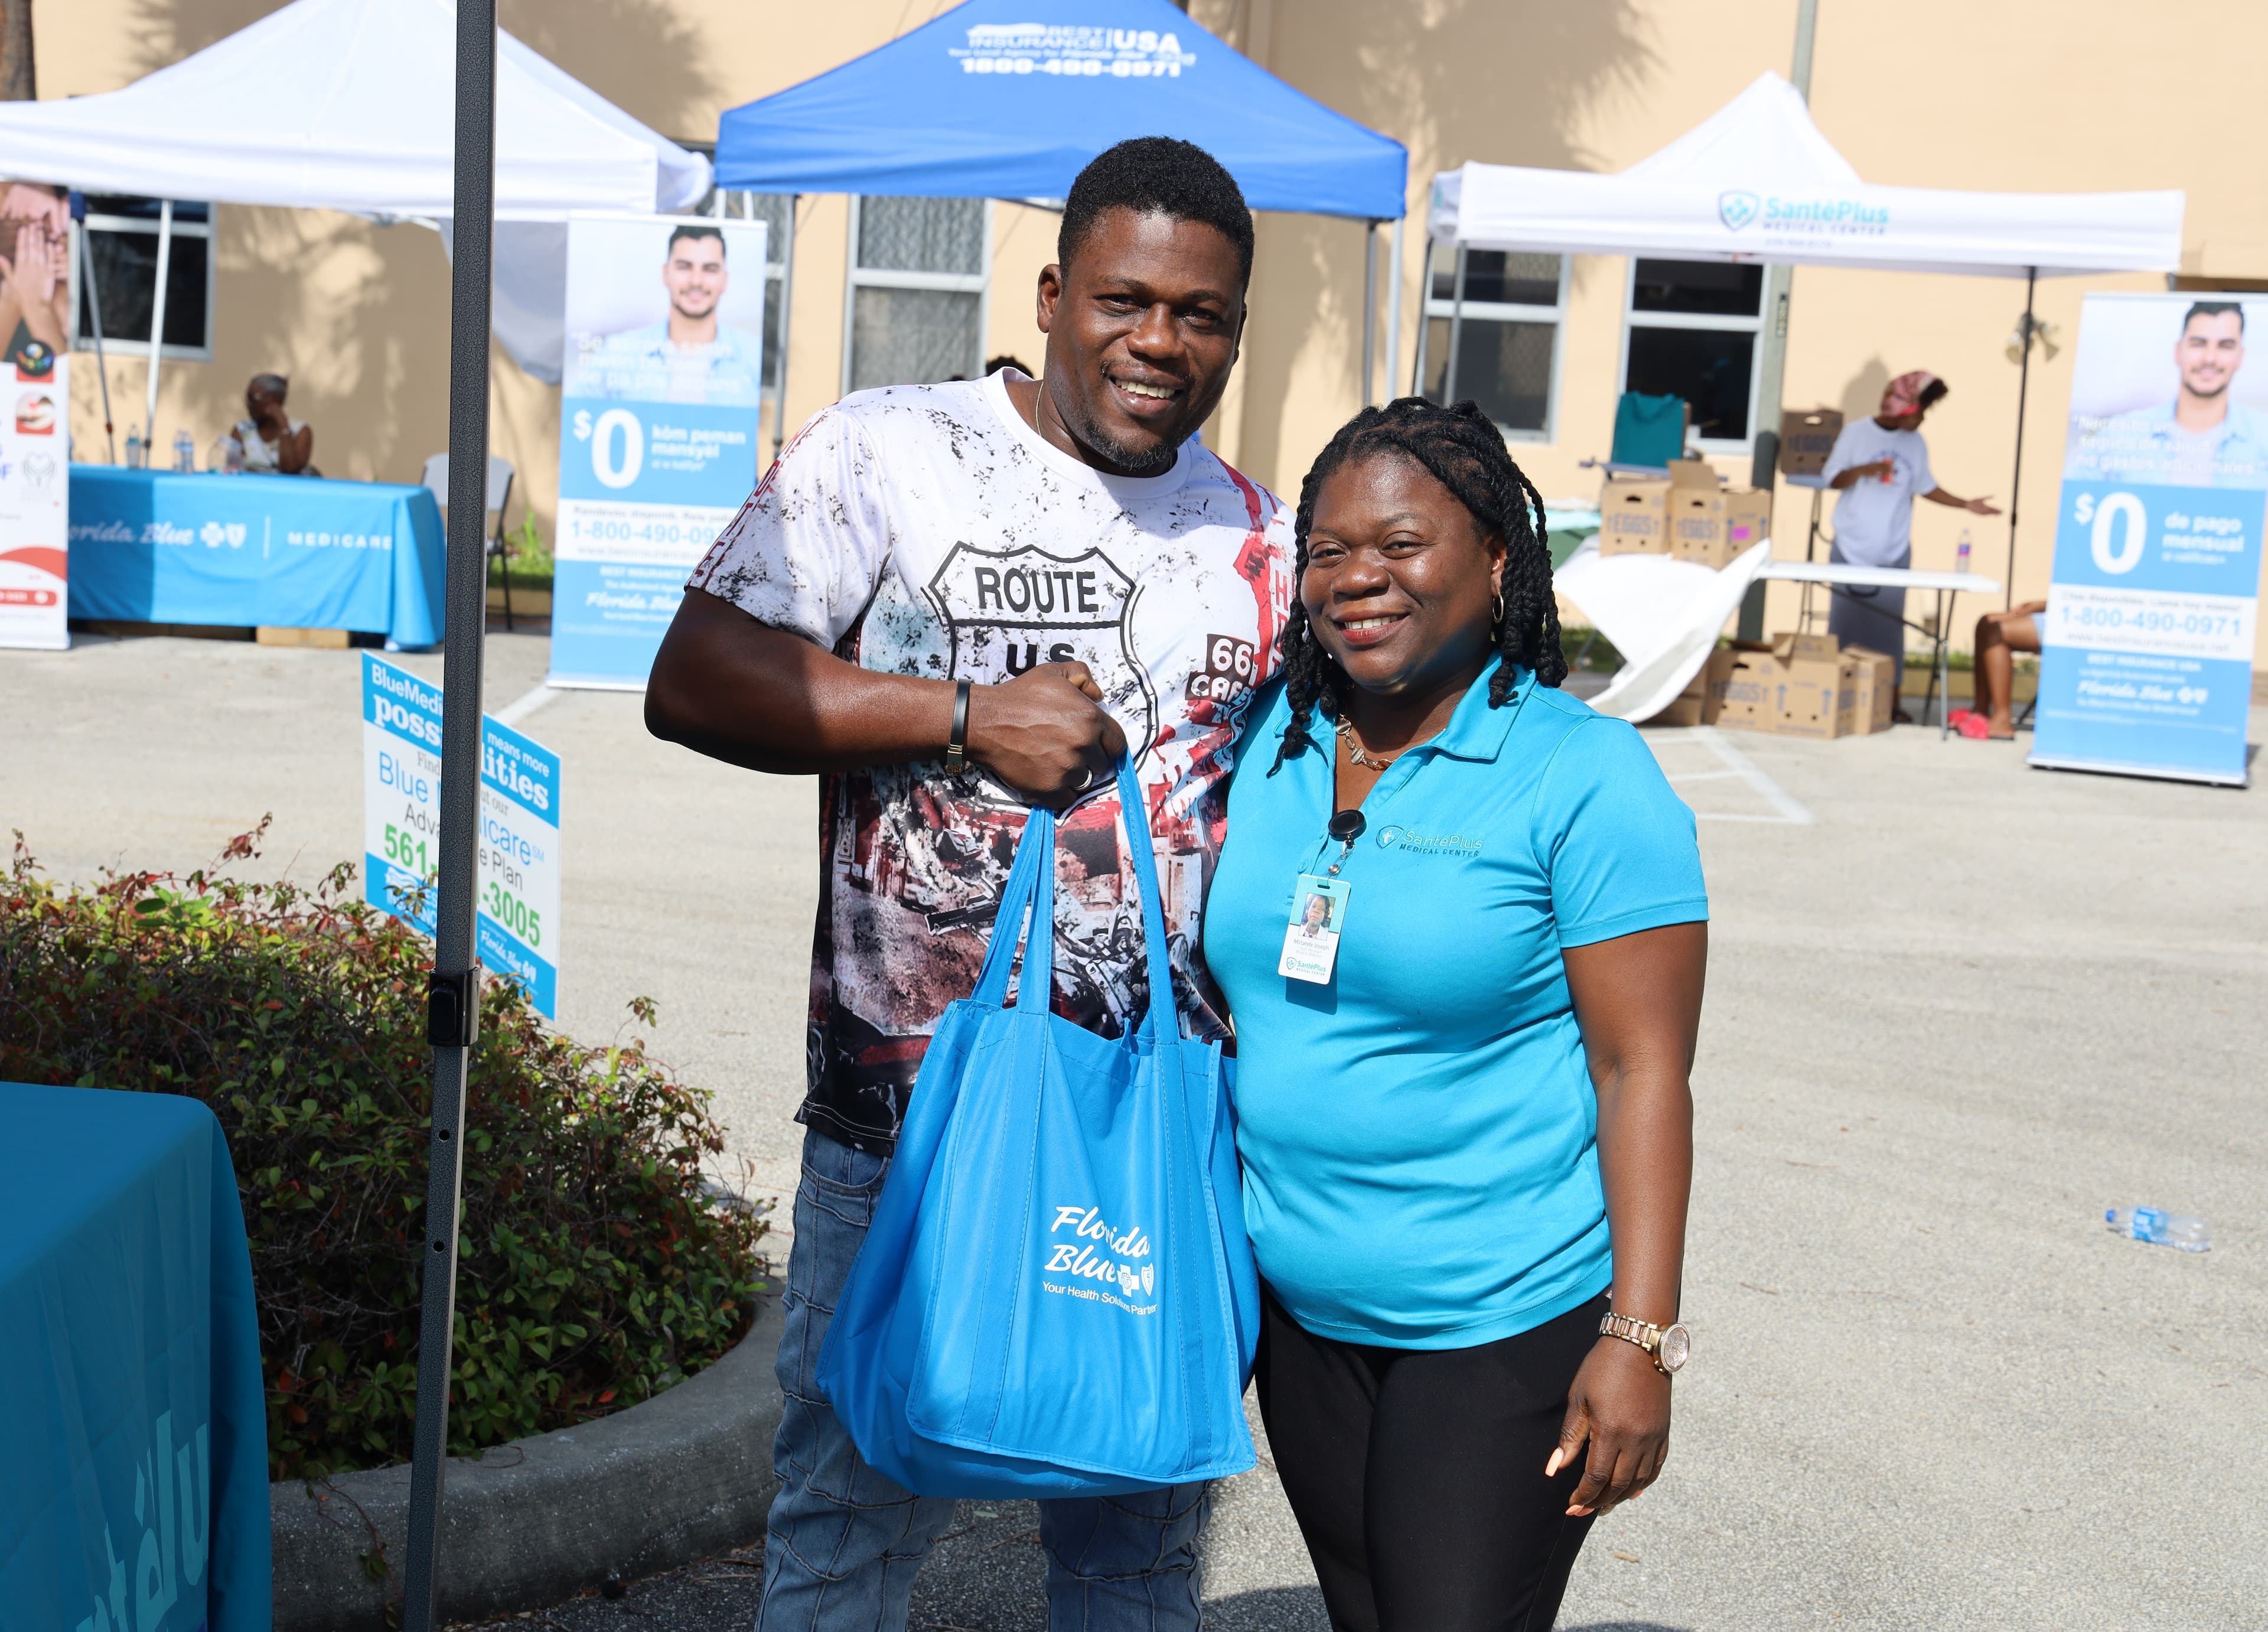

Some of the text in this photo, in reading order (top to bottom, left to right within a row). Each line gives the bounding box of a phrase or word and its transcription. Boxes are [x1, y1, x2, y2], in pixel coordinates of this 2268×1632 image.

[1113, 29, 1181, 54] USA
[69, 519, 392, 550] orida Blue MEDICARE
[572, 520, 716, 545] 1-800-490-09
[2192, 516, 2243, 536] pago
[975, 566, 1099, 614] ROUTE
[2062, 605, 2240, 637] 1-800-490-0971
[1212, 638, 1253, 676] 66
[372, 662, 549, 778] BlueMedi means more
[380, 751, 428, 803] Blue
[1399, 843, 1480, 857] MEDICAL CENTER
[1403, 830, 1482, 849] SantéPlus
[493, 851, 523, 891] Plan
[1314, 942, 1329, 950] Joseph
[1296, 960, 1327, 973] SantéPlus
[1050, 1206, 1151, 1258] Florida
[1044, 1244, 1116, 1283] Blue
[1042, 1281, 1066, 1294] Your
[1067, 1286, 1100, 1301] Health
